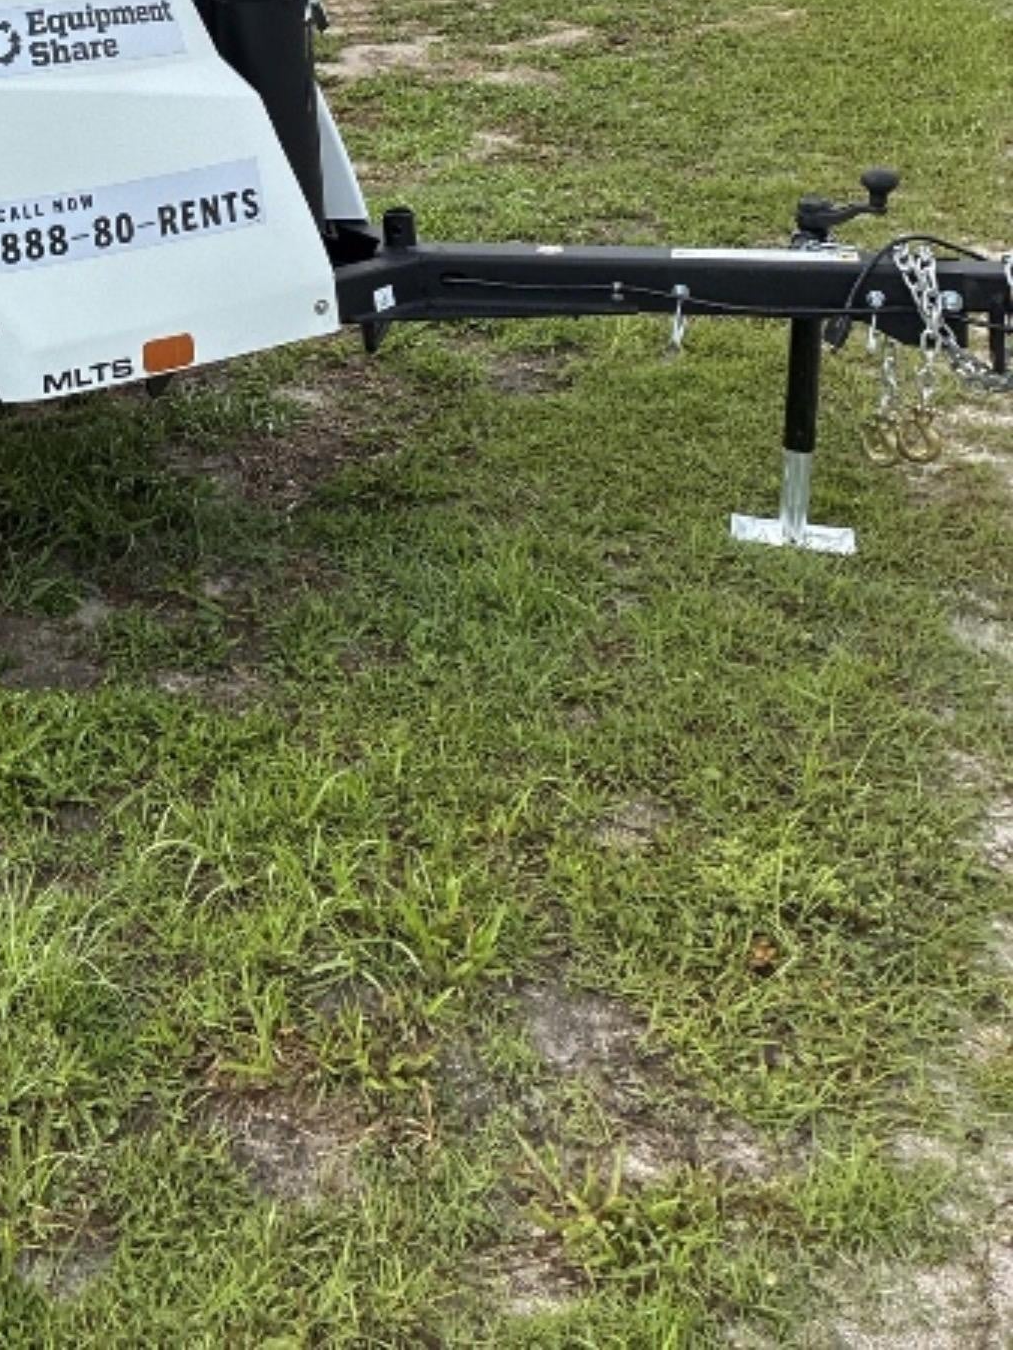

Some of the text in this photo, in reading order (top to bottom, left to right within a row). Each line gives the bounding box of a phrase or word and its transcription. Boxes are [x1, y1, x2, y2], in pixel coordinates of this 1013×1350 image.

[26, 0, 173, 37] Equipment
[29, 38, 119, 66] Share
[52, 194, 93, 213] NOW
[0, 188, 260, 264] 888-80-RENTS
